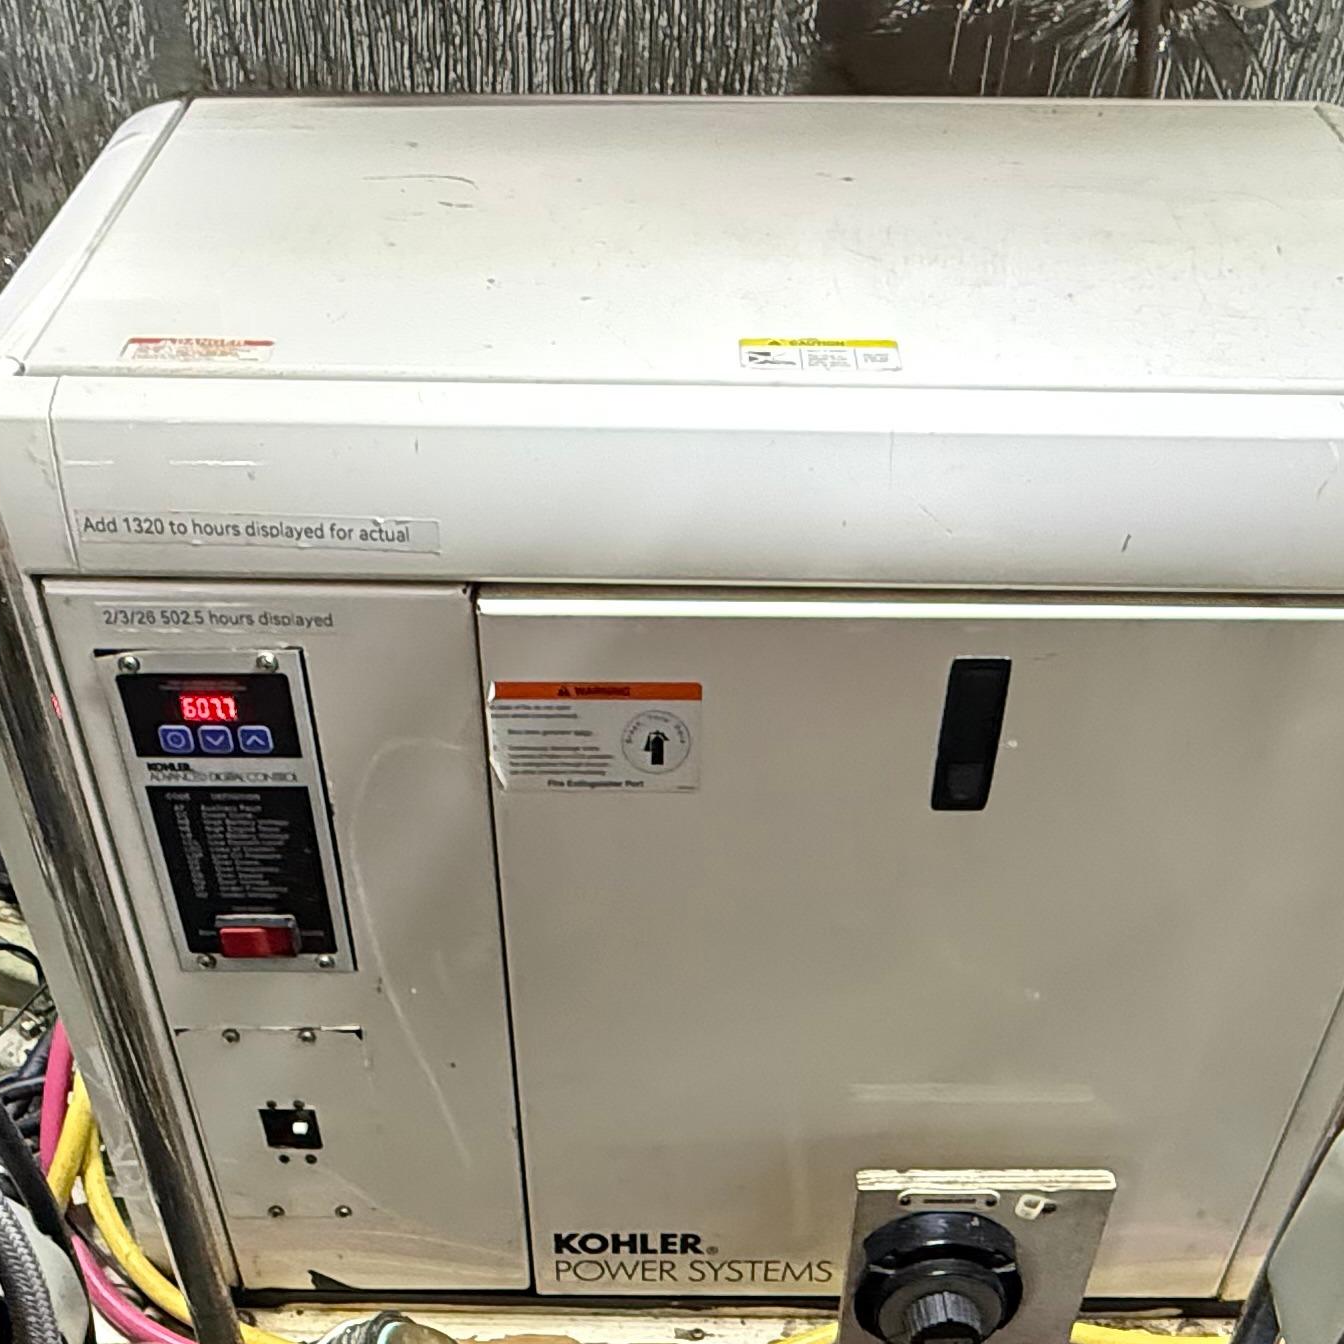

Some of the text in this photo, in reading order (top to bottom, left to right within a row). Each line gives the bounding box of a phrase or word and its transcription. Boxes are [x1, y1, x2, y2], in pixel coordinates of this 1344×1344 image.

[84, 517, 410, 543] Add 1320 to hours displayed for actual
[102, 609, 334, 629] 2/3/26 502.5 hours displayed
[575, 687, 631, 697] WARNING
[146, 762, 191, 772] KOHLER
[553, 1233, 706, 1255] KOHLER
[555, 1259, 833, 1283] POWER SYSTEMS
